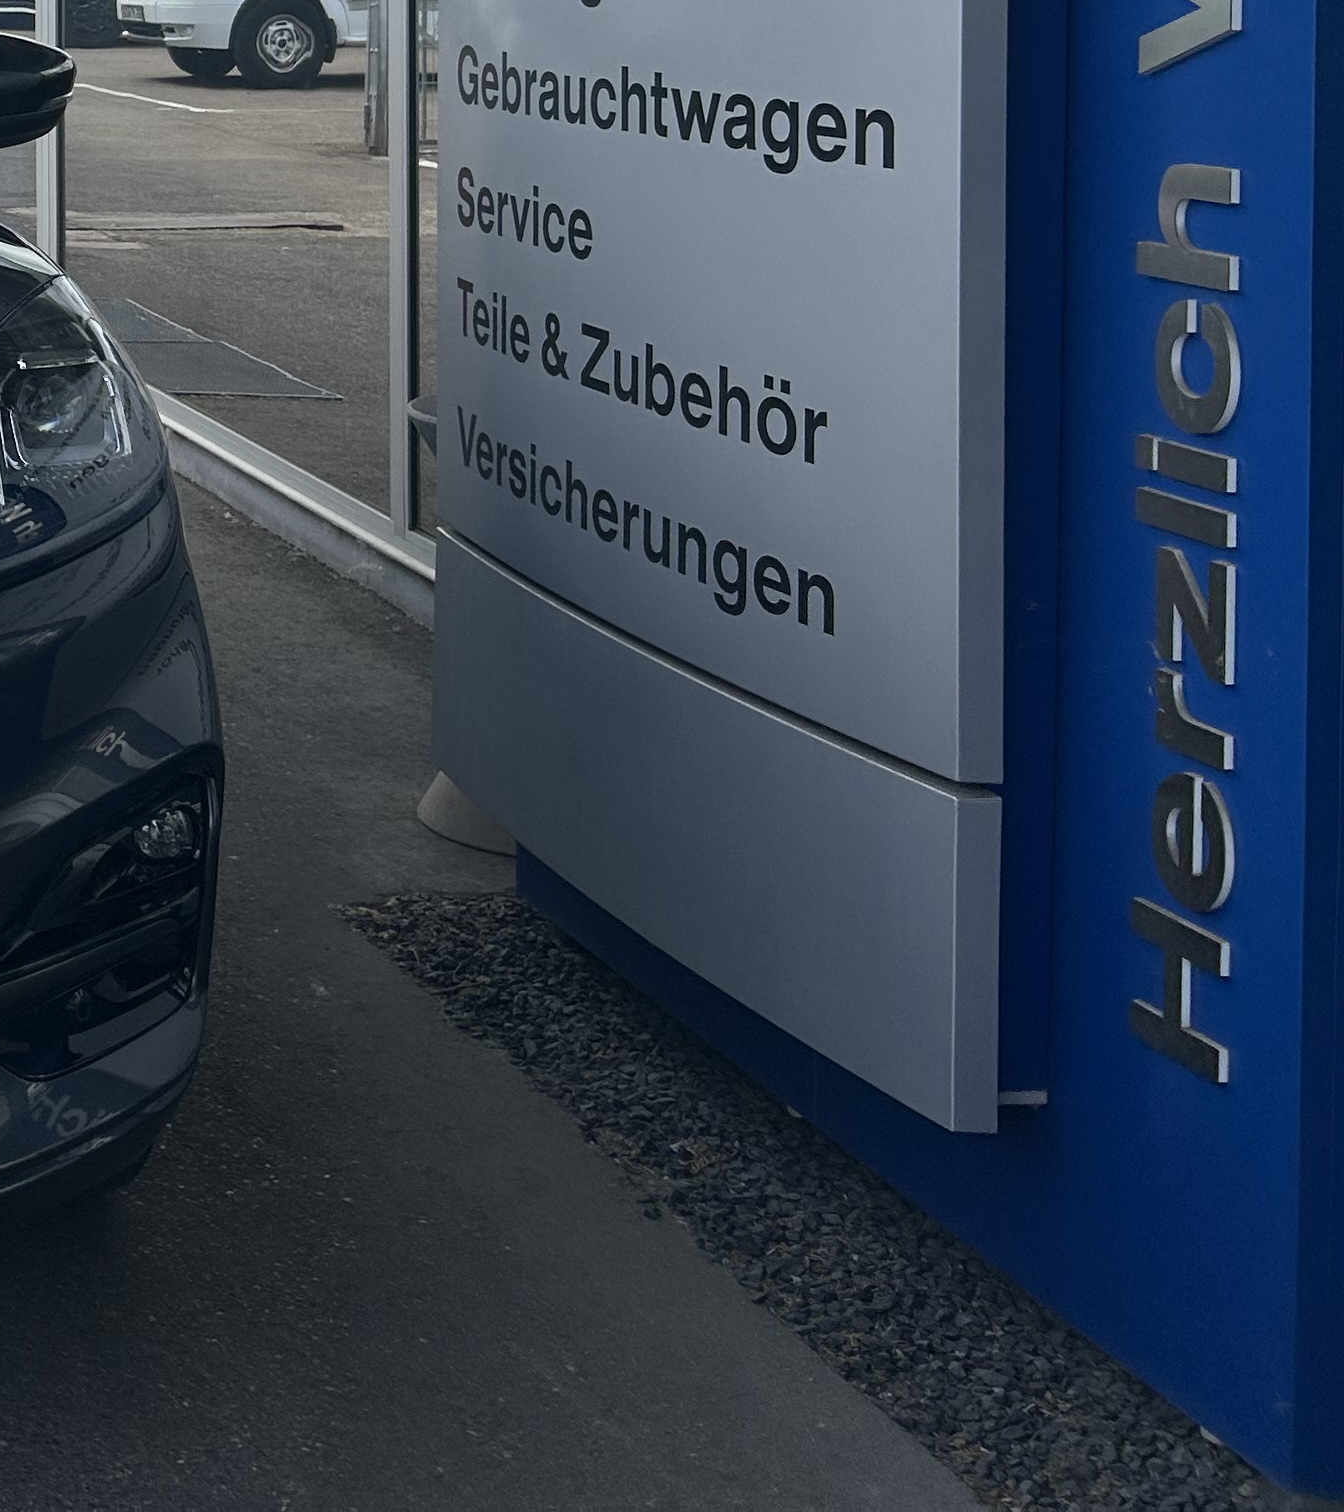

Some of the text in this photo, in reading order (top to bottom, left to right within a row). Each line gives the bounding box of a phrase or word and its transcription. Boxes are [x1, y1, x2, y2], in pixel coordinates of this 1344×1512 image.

[456, 44, 896, 174] Gebrauchtwagen
[456, 166, 594, 260] Service
[456, 276, 828, 465] Teile & Zubehör
[456, 404, 836, 637] Versicherungen
[1131, 164, 1242, 1085] Herzlich
